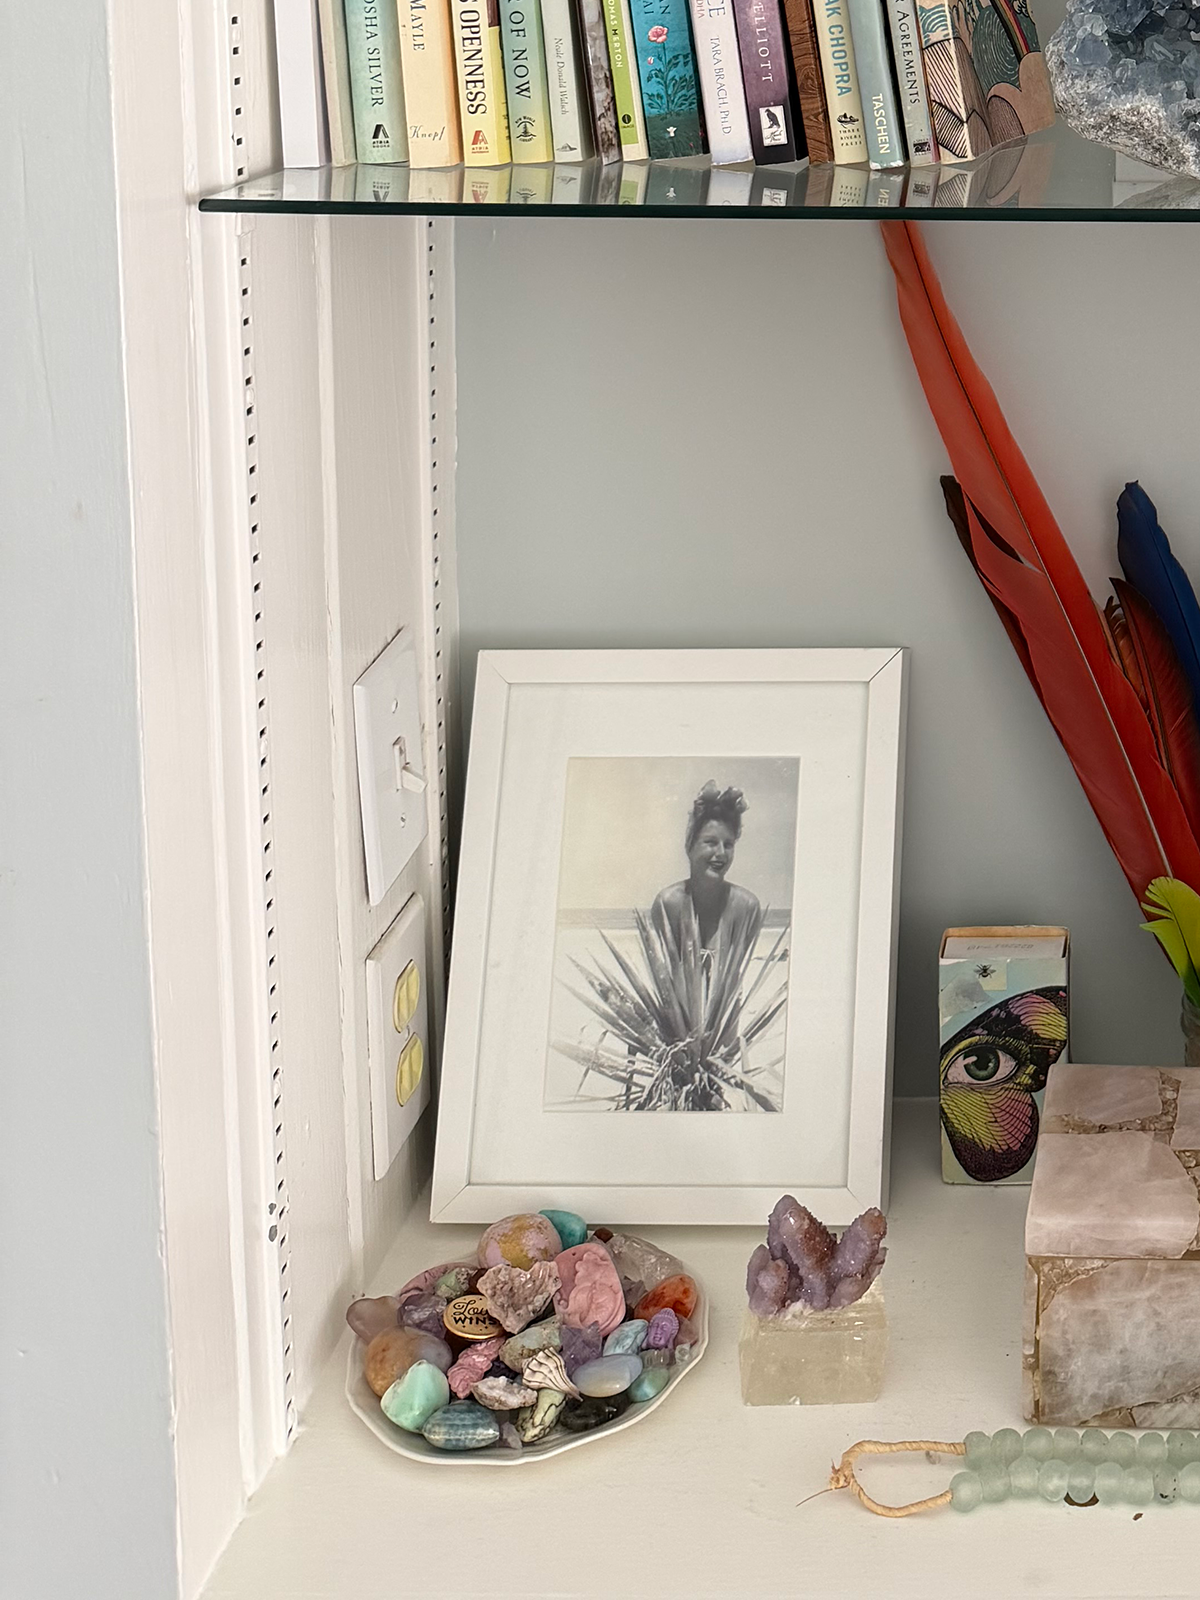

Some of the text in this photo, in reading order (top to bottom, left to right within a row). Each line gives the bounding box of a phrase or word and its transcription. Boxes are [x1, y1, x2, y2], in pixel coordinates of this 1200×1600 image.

[510, 11, 526, 38] OF
[459, 10, 487, 115] OPENNESS
[512, 47, 531, 99] NOW
[827, 24, 852, 97] CHOPRA
[872, 93, 891, 154] TASCHEN
